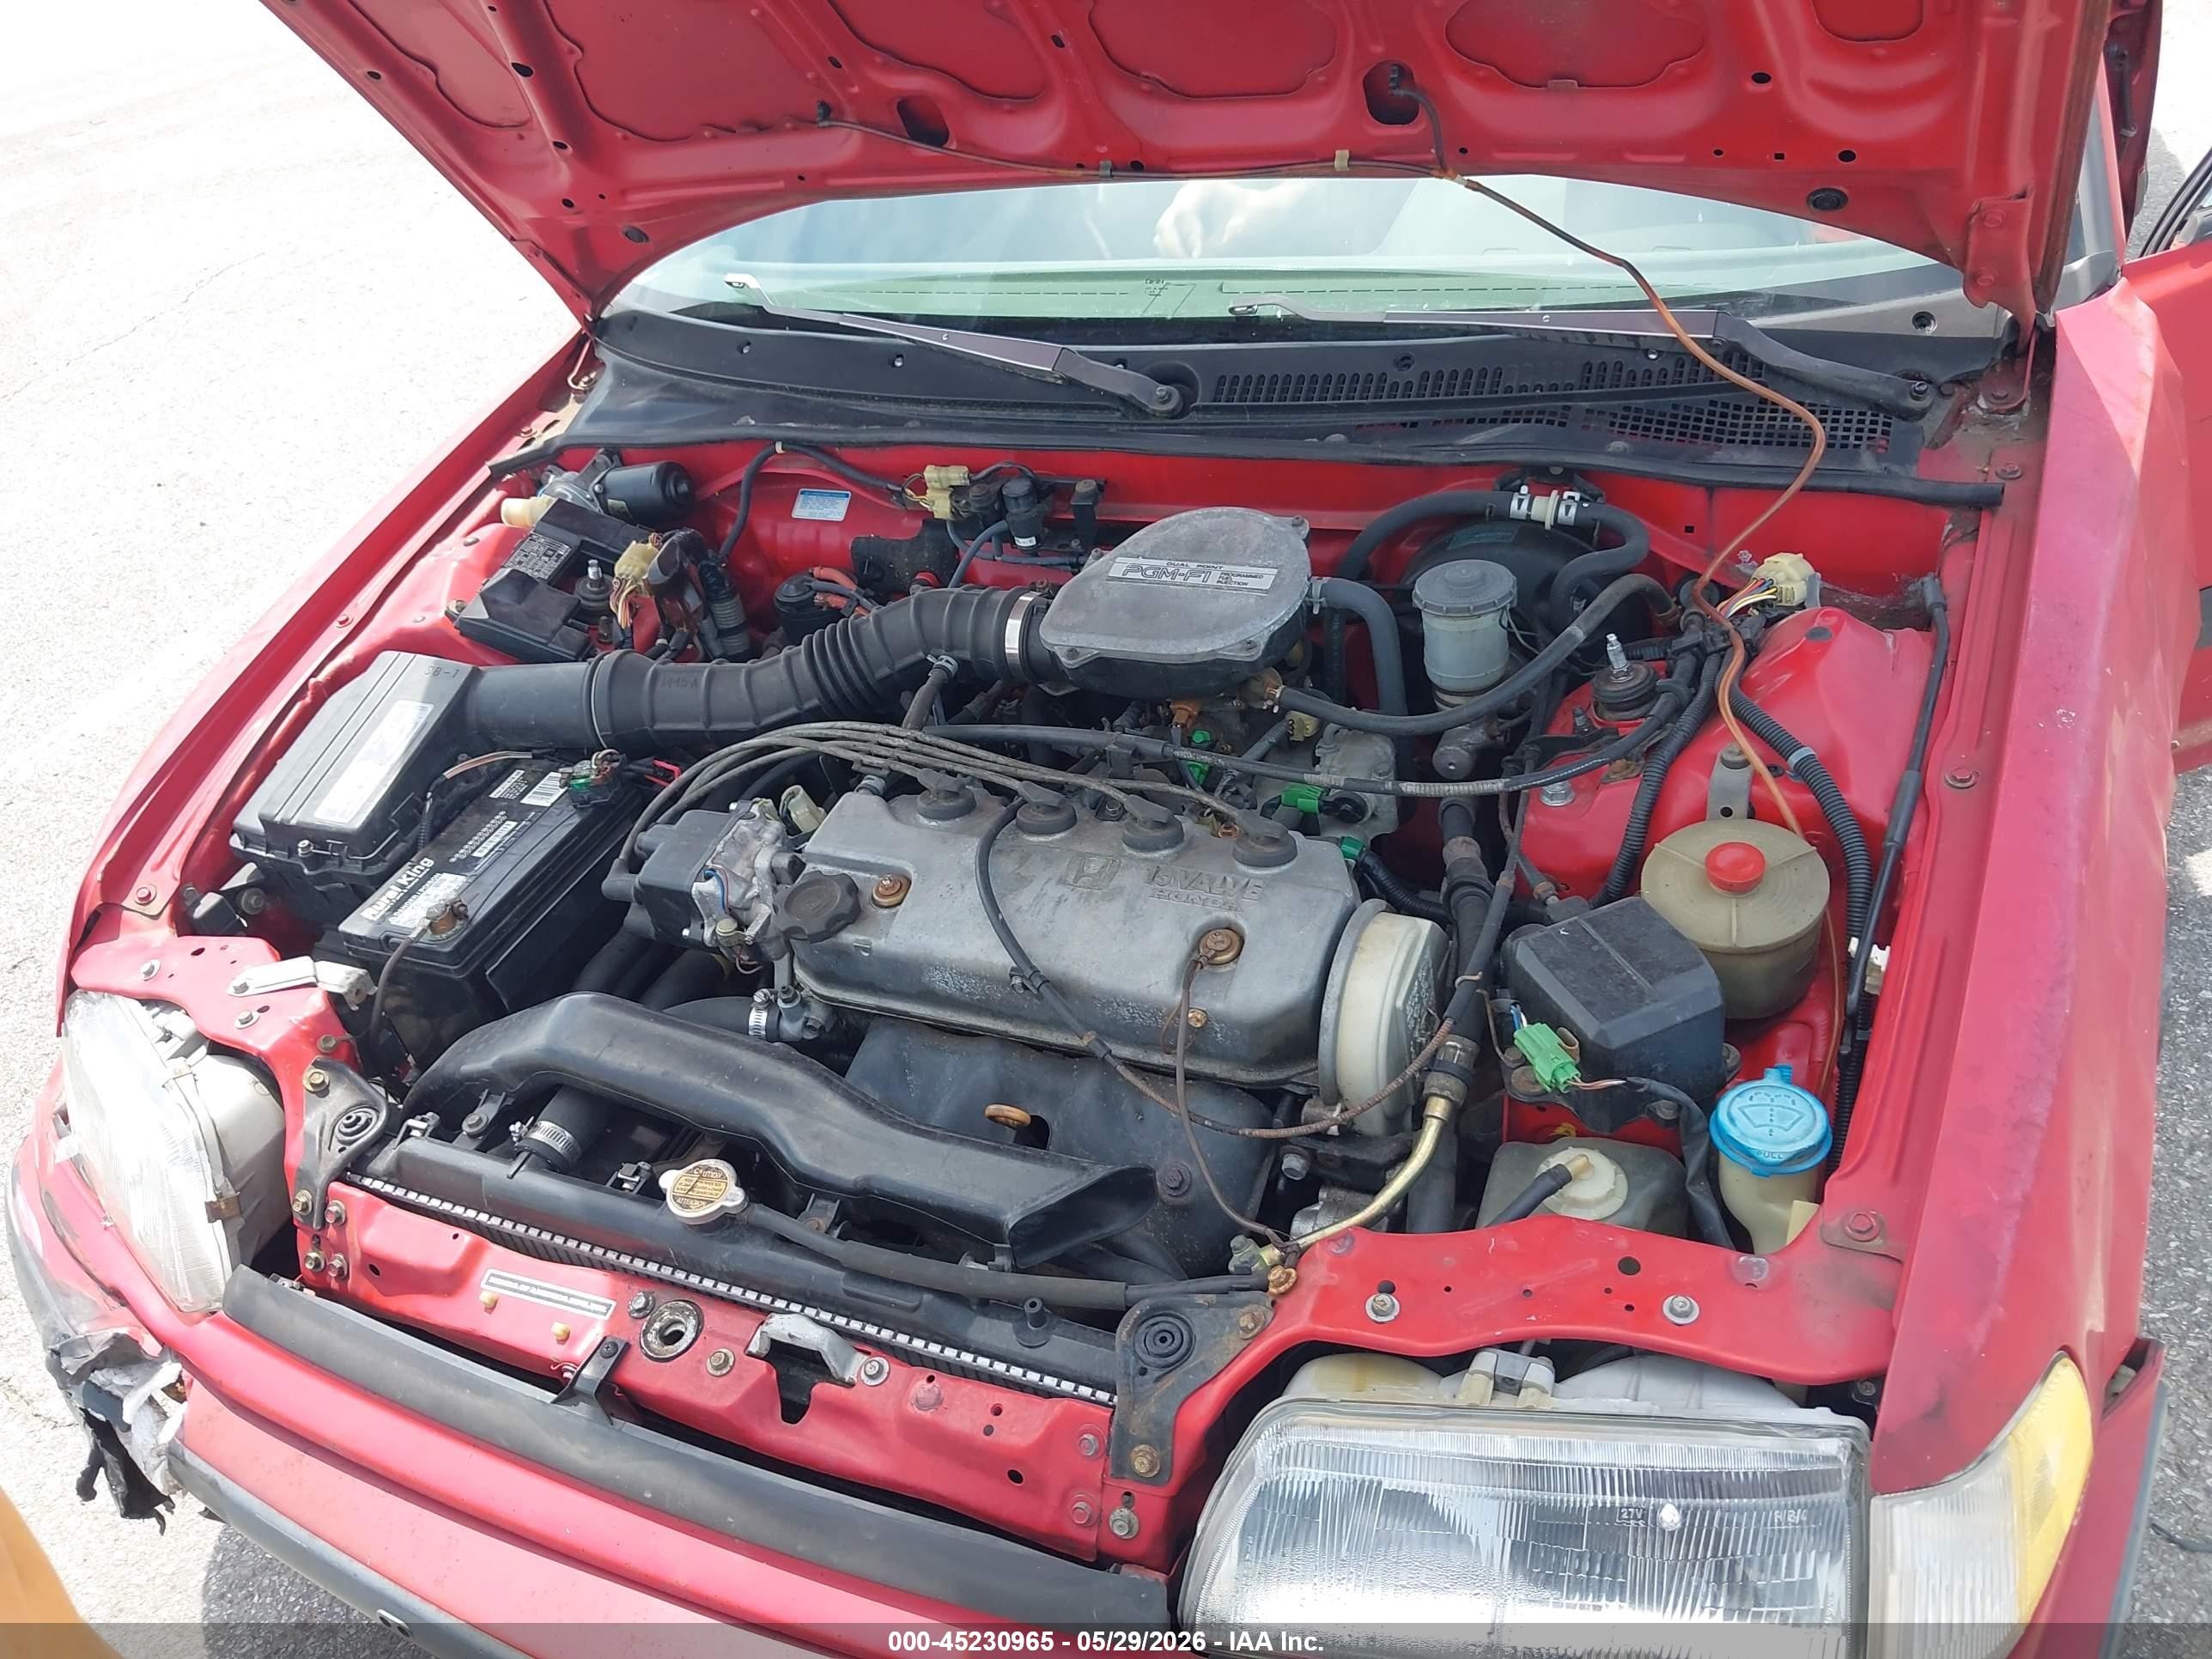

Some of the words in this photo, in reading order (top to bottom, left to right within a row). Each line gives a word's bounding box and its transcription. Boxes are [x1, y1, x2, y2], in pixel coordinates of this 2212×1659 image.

[1121, 562, 1212, 583] PGM-FI
[360, 884, 403, 921] Rural
[397, 857, 434, 886] King
